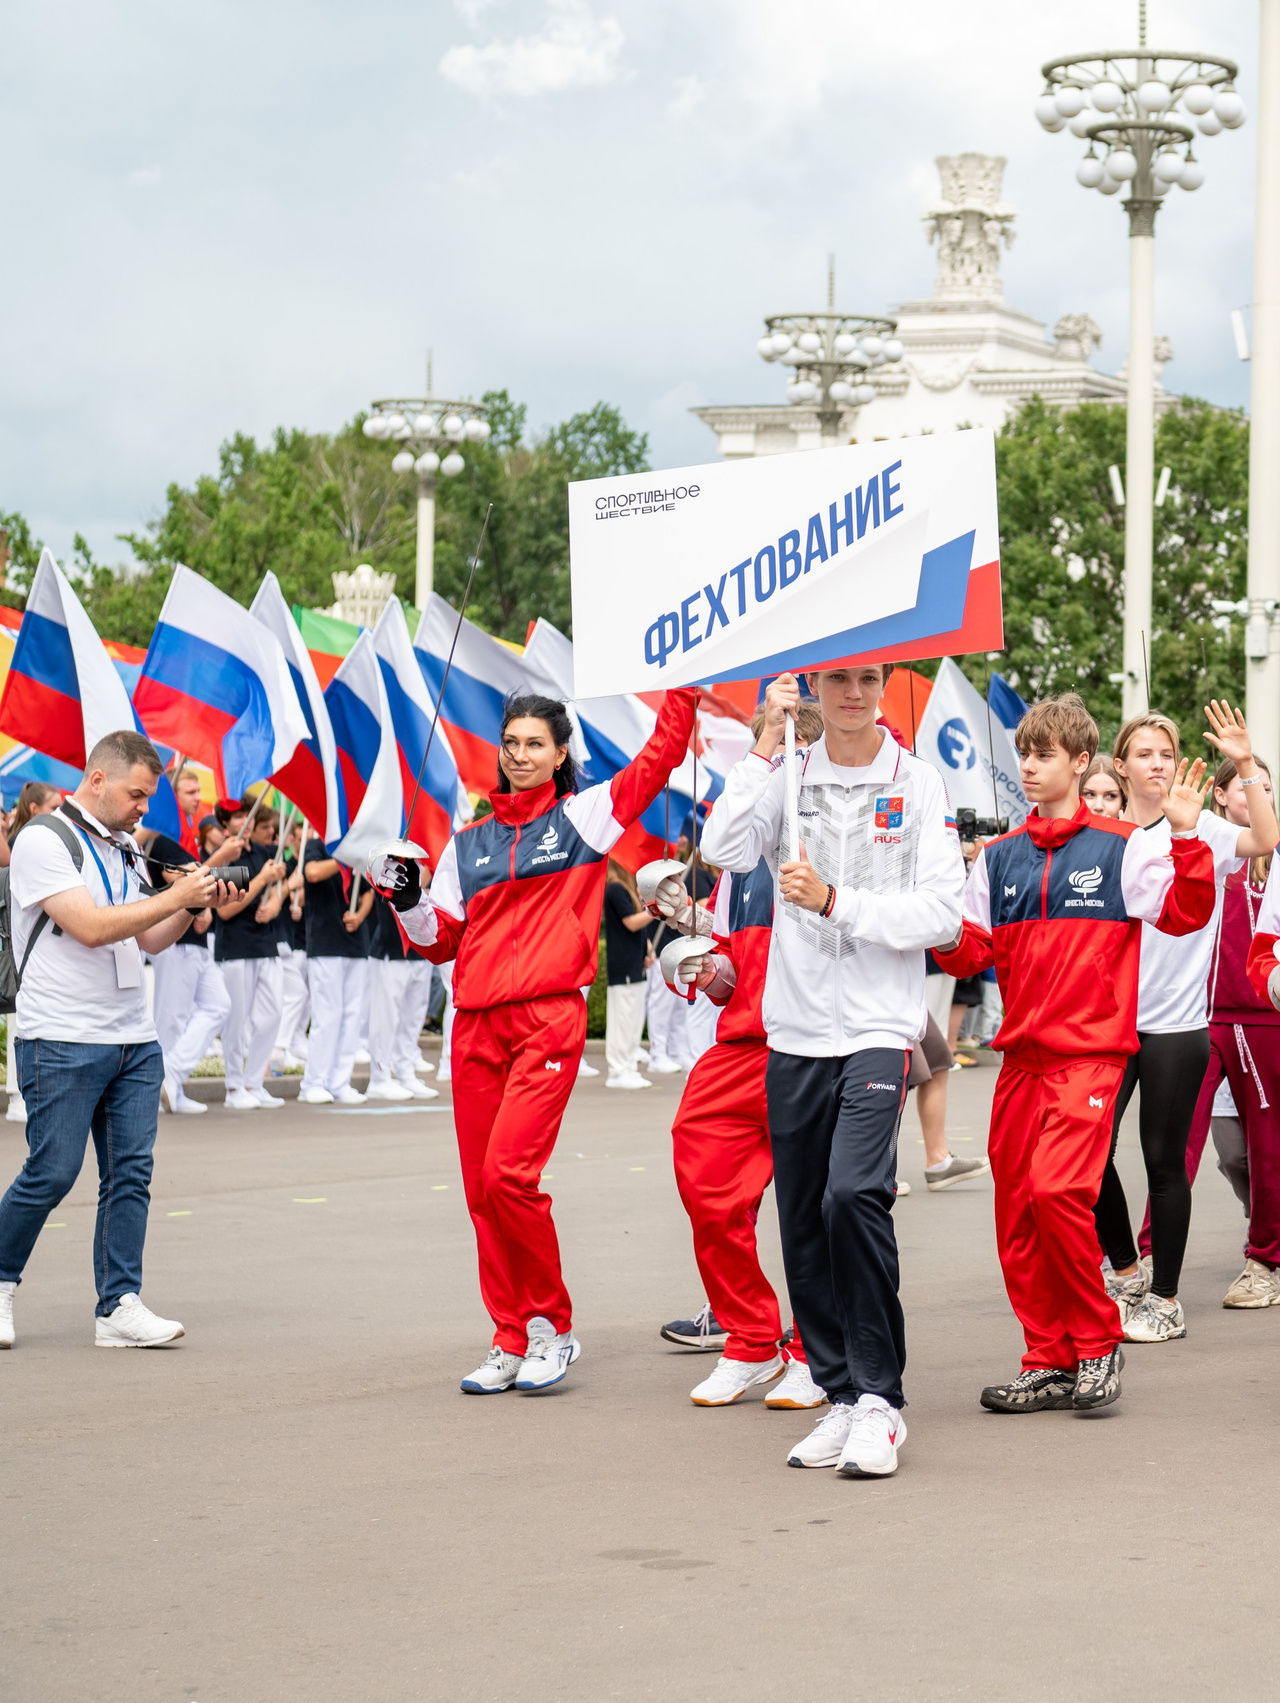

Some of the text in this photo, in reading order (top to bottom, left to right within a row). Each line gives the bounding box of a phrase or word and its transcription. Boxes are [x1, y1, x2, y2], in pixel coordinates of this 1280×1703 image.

[595, 503, 676, 520] ШЕСТВИЕ
[644, 459, 904, 669] ФЕХТОВАНИЕ
[874, 835, 902, 844] RUS
[866, 1082, 897, 1091] FORWARD
